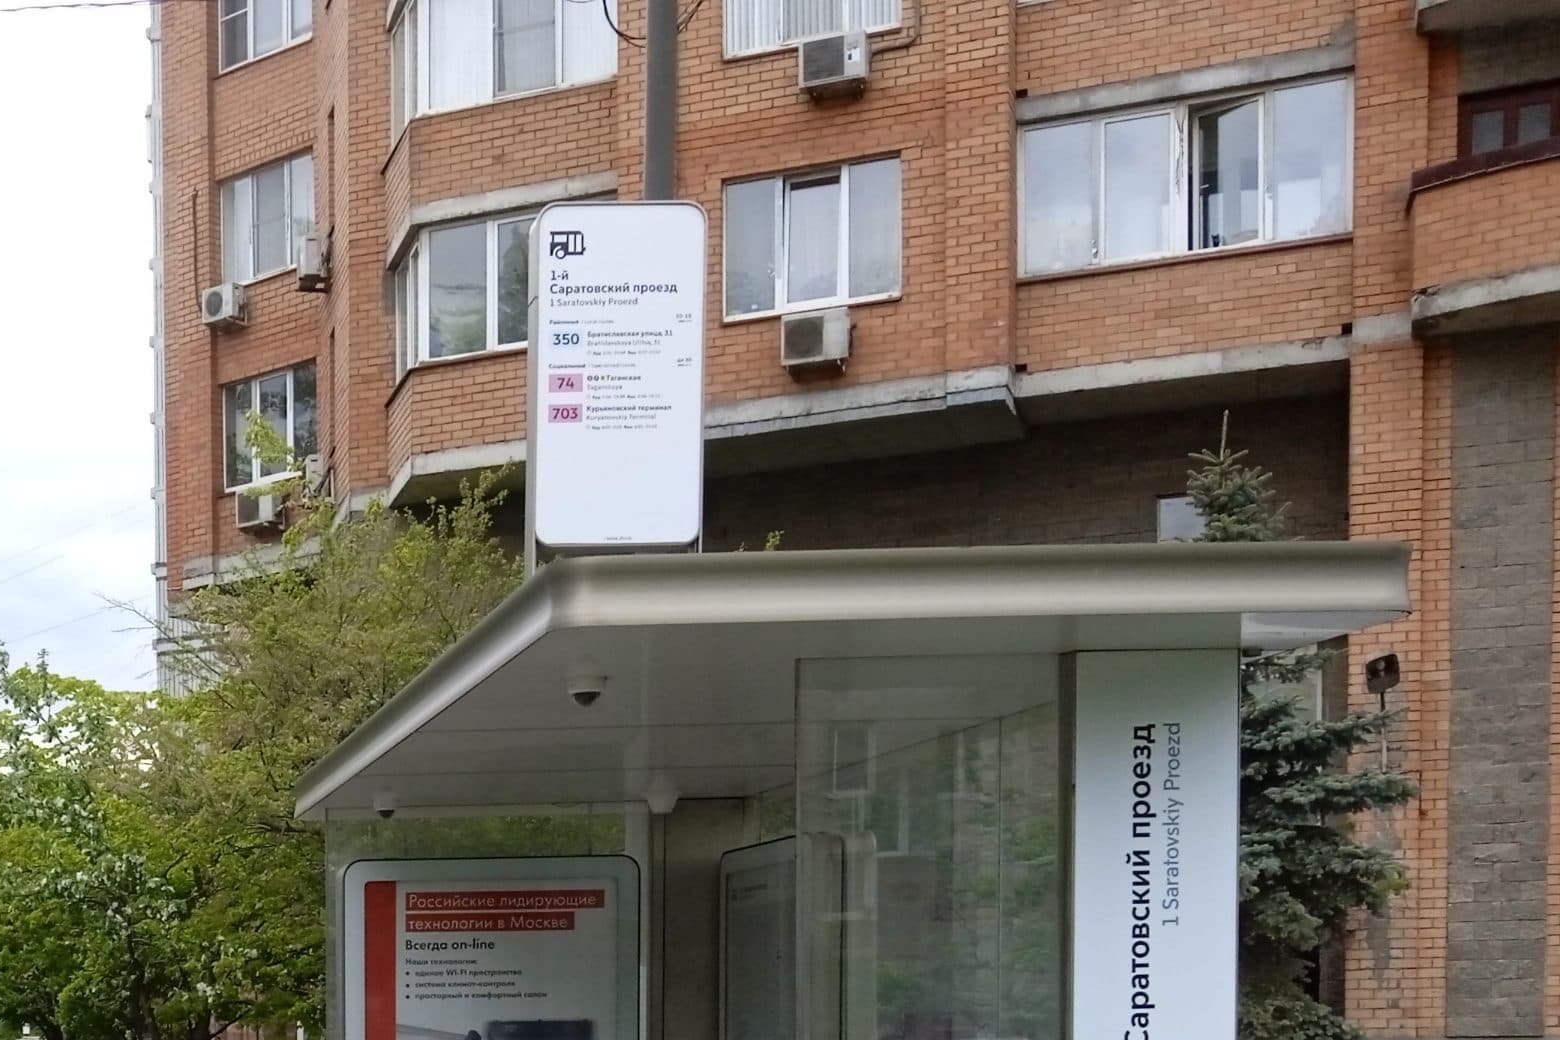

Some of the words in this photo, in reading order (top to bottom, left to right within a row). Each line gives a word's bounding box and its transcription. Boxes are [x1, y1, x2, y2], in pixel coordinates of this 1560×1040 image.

[550, 270, 569, 281] 1-й
[550, 283, 630, 296] Саратовский
[633, 283, 678, 294] проезд
[557, 297, 607, 307] Saratovskiy
[608, 297, 639, 306] Proezd
[553, 333, 580, 346] 350
[557, 377, 575, 390] 74
[552, 407, 579, 420] 703
[1162, 721, 1181, 792] Proezd
[1131, 722, 1157, 839] проезд
[1162, 798, 1185, 910] Saratovskiy
[408, 893, 495, 909] Российские
[500, 892, 598, 908] лидирующие
[407, 917, 493, 931] технологии
[498, 919, 505, 929] в
[510, 915, 569, 930] Москве
[1162, 915, 1179, 927] 1
[405, 938, 448, 952] Всегда
[452, 938, 495, 951] on-line
